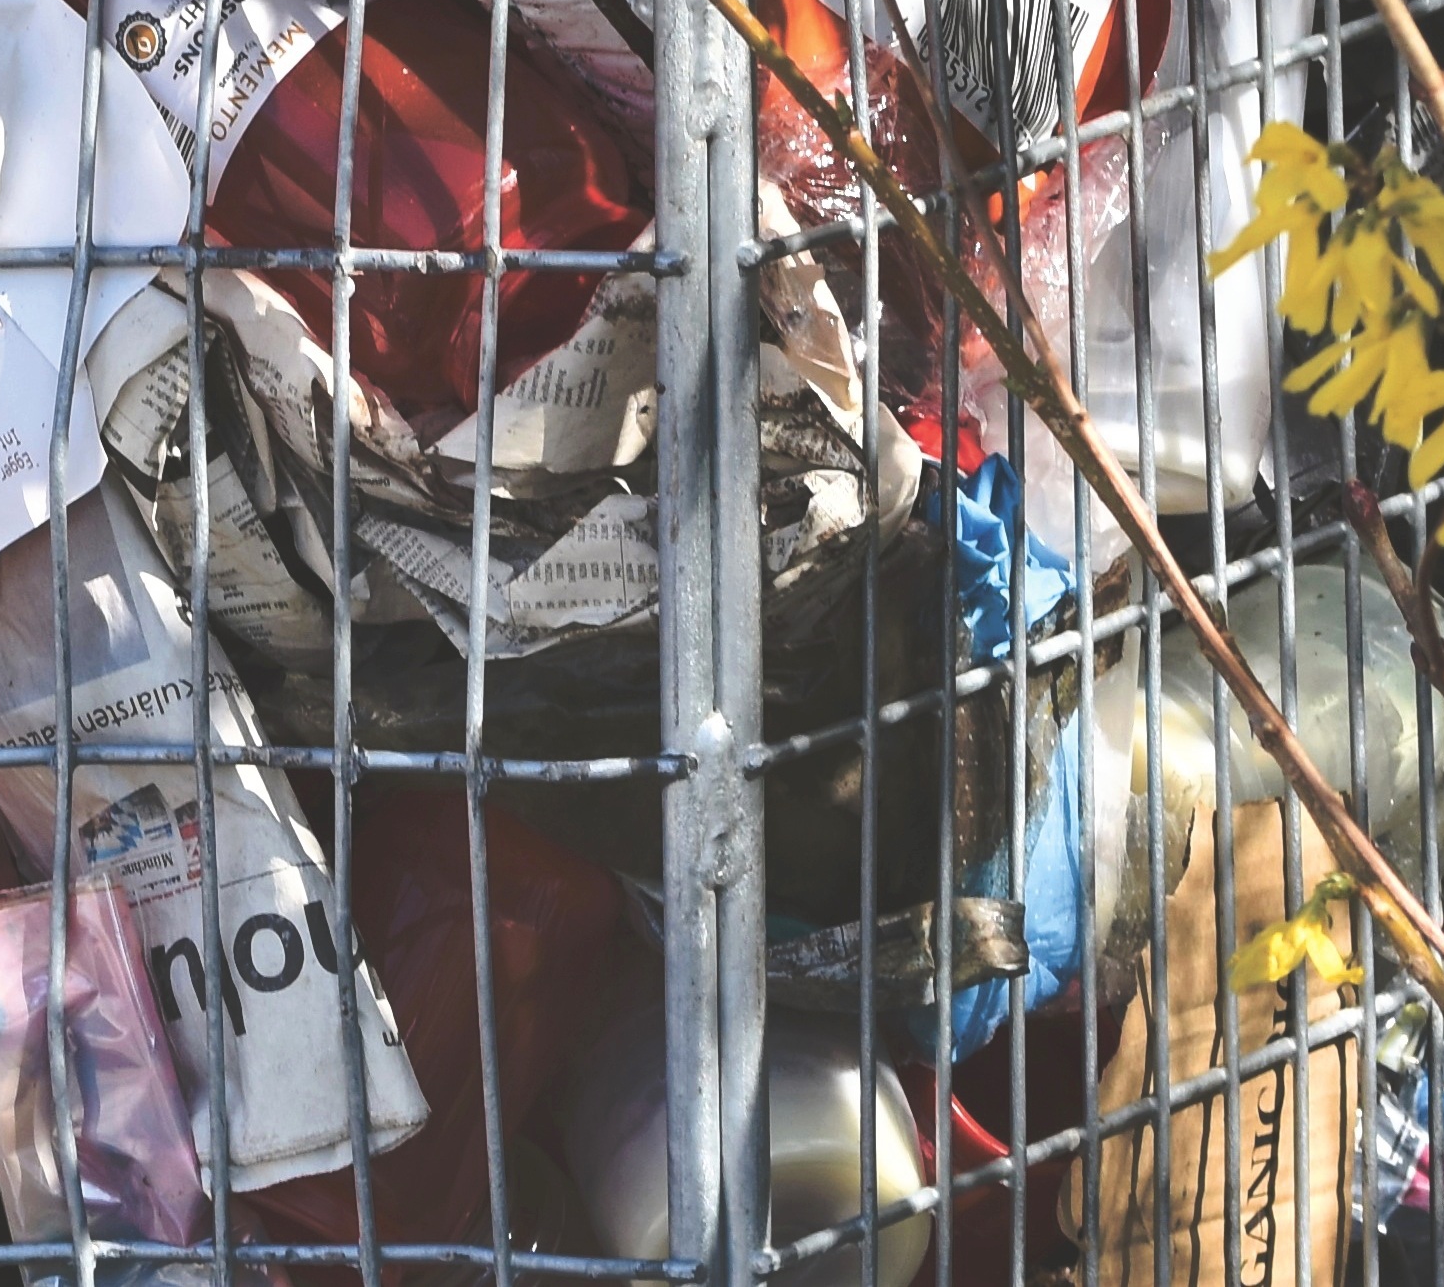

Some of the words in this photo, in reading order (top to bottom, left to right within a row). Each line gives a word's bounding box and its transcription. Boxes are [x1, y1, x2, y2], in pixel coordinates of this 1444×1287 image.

[242, 38, 258, 51] by
[206, 21, 307, 143] MEMENTO
[120, 851, 173, 879] Münchne
